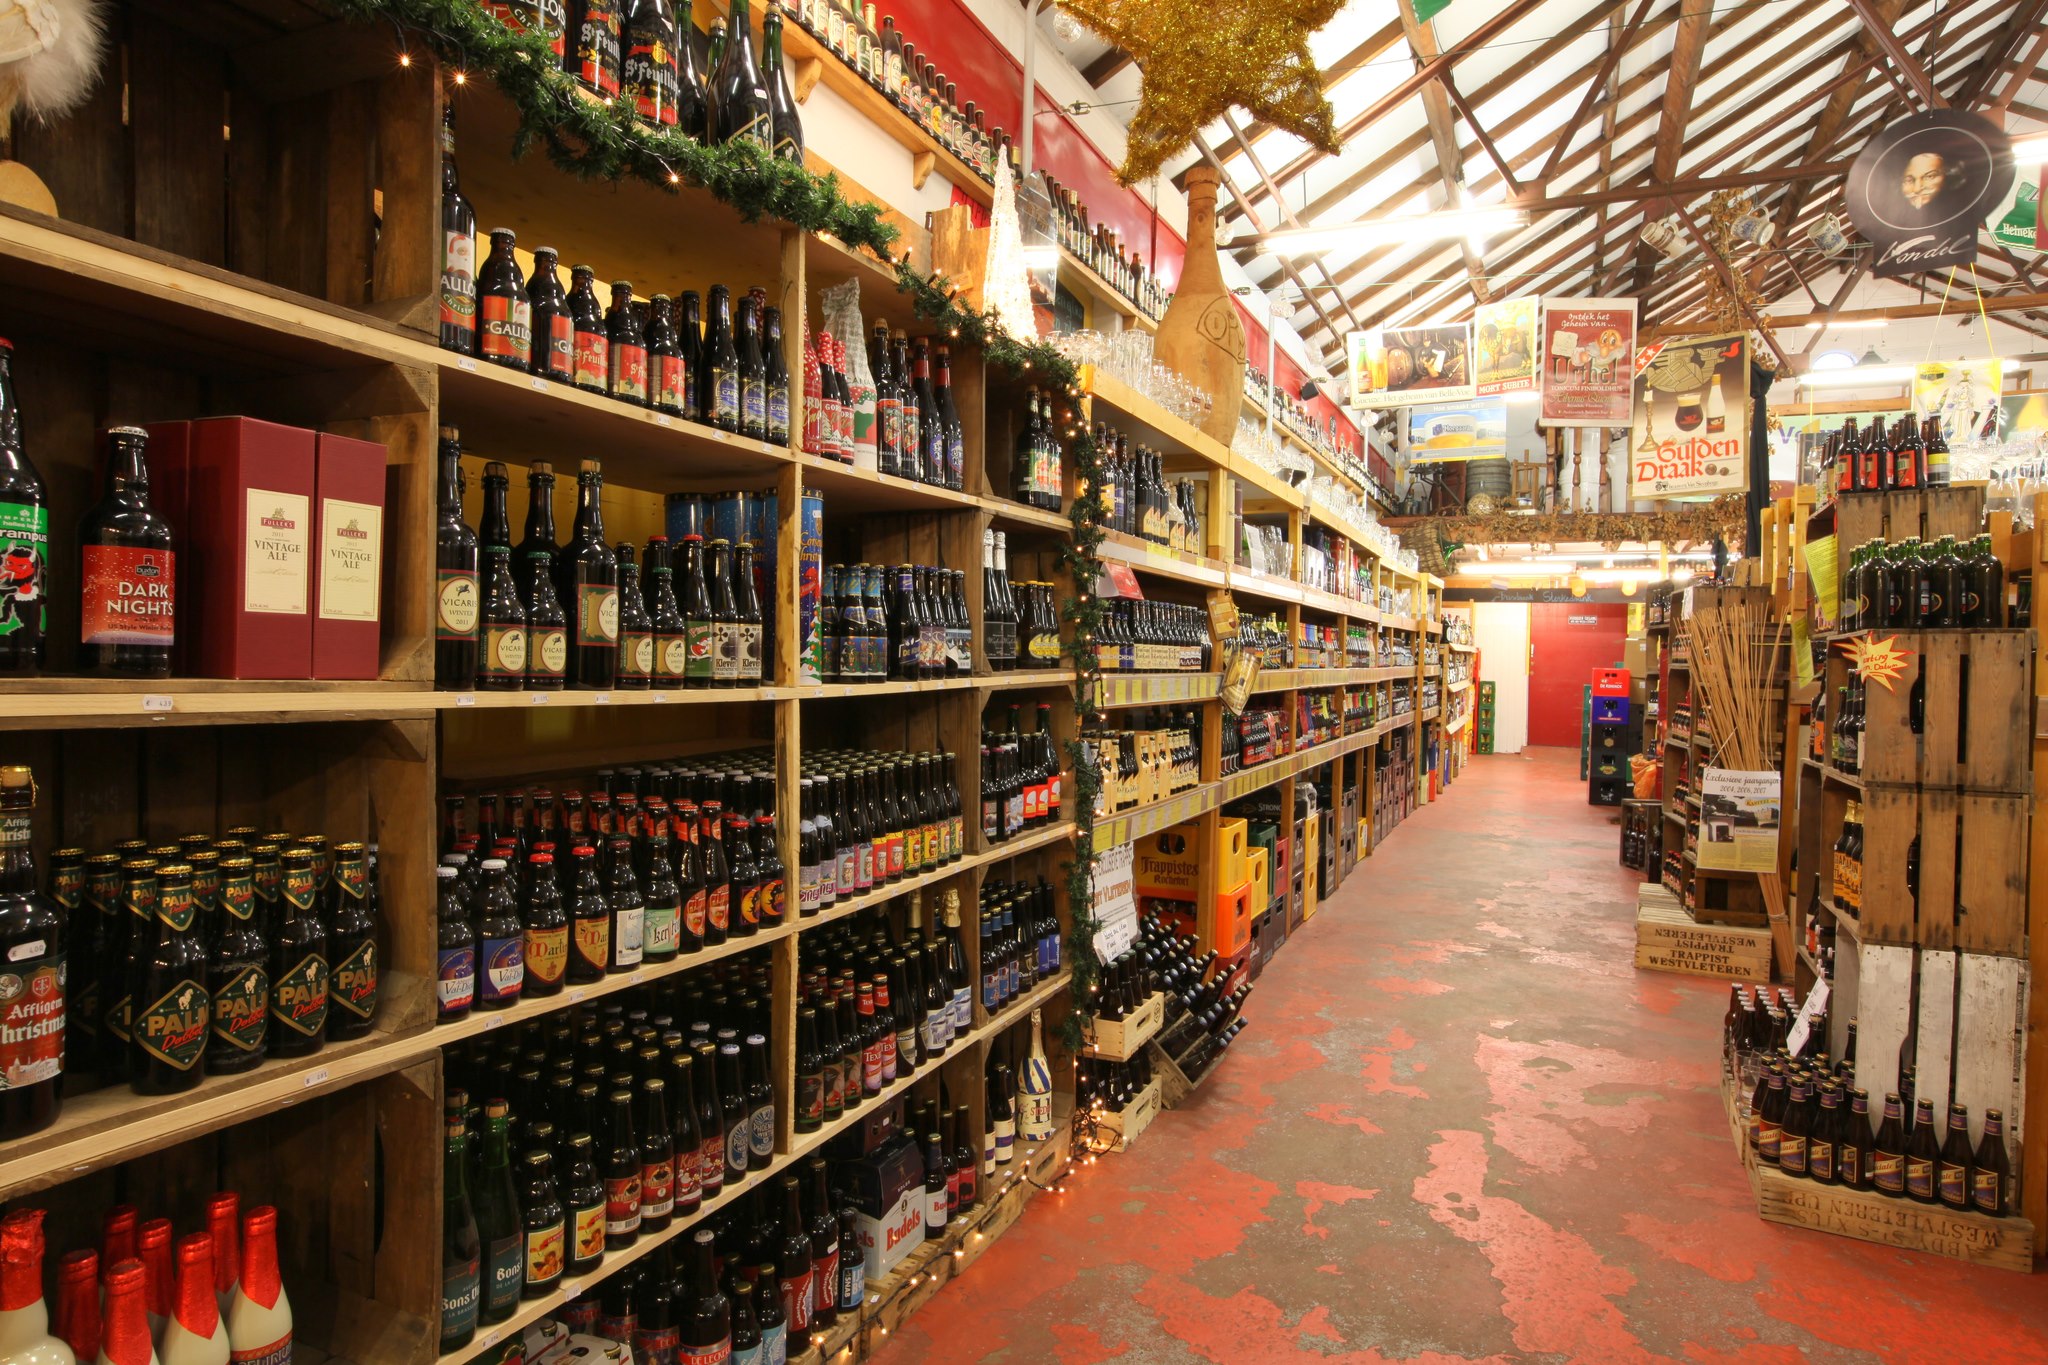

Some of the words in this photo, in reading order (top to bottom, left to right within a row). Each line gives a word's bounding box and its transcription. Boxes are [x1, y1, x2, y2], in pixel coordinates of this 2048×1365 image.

[514, 8, 562, 38] Chrismas
[521, 0, 567, 27] LOIS
[1876, 235, 1971, 267] Vondel
[440, 274, 476, 300] AULO
[1596, 312, 1611, 321] het
[1552, 356, 1620, 385] Urthel
[1479, 384, 1501, 394] MORT
[1502, 379, 1530, 391] SUBITE
[1656, 437, 1739, 463] Gulden
[1635, 460, 1704, 482] Draak
[0, 515, 43, 525] MPERIL
[0, 528, 47, 543] rampus
[254, 539, 301, 554] VINTAGE
[331, 549, 372, 562] VINTAGE
[267, 551, 288, 562] ALE
[342, 560, 360, 569] ALE
[118, 581, 169, 599] DARK
[106, 599, 174, 616] NIGHTS
[1705, 773, 1742, 784] Exclusieve
[1141, 856, 1199, 877] Trappistes
[1655, 928, 1757, 948] WESTVLETEREN
[1675, 940, 1734, 954] TRAPPIST
[1649, 956, 1751, 976] WESTVLETEREN
[1670, 949, 1730, 964] TRAPPIST
[7, 998, 63, 1021] Affligem
[0, 1013, 66, 1046] hristma
[886, 1208, 921, 1251] Budels
